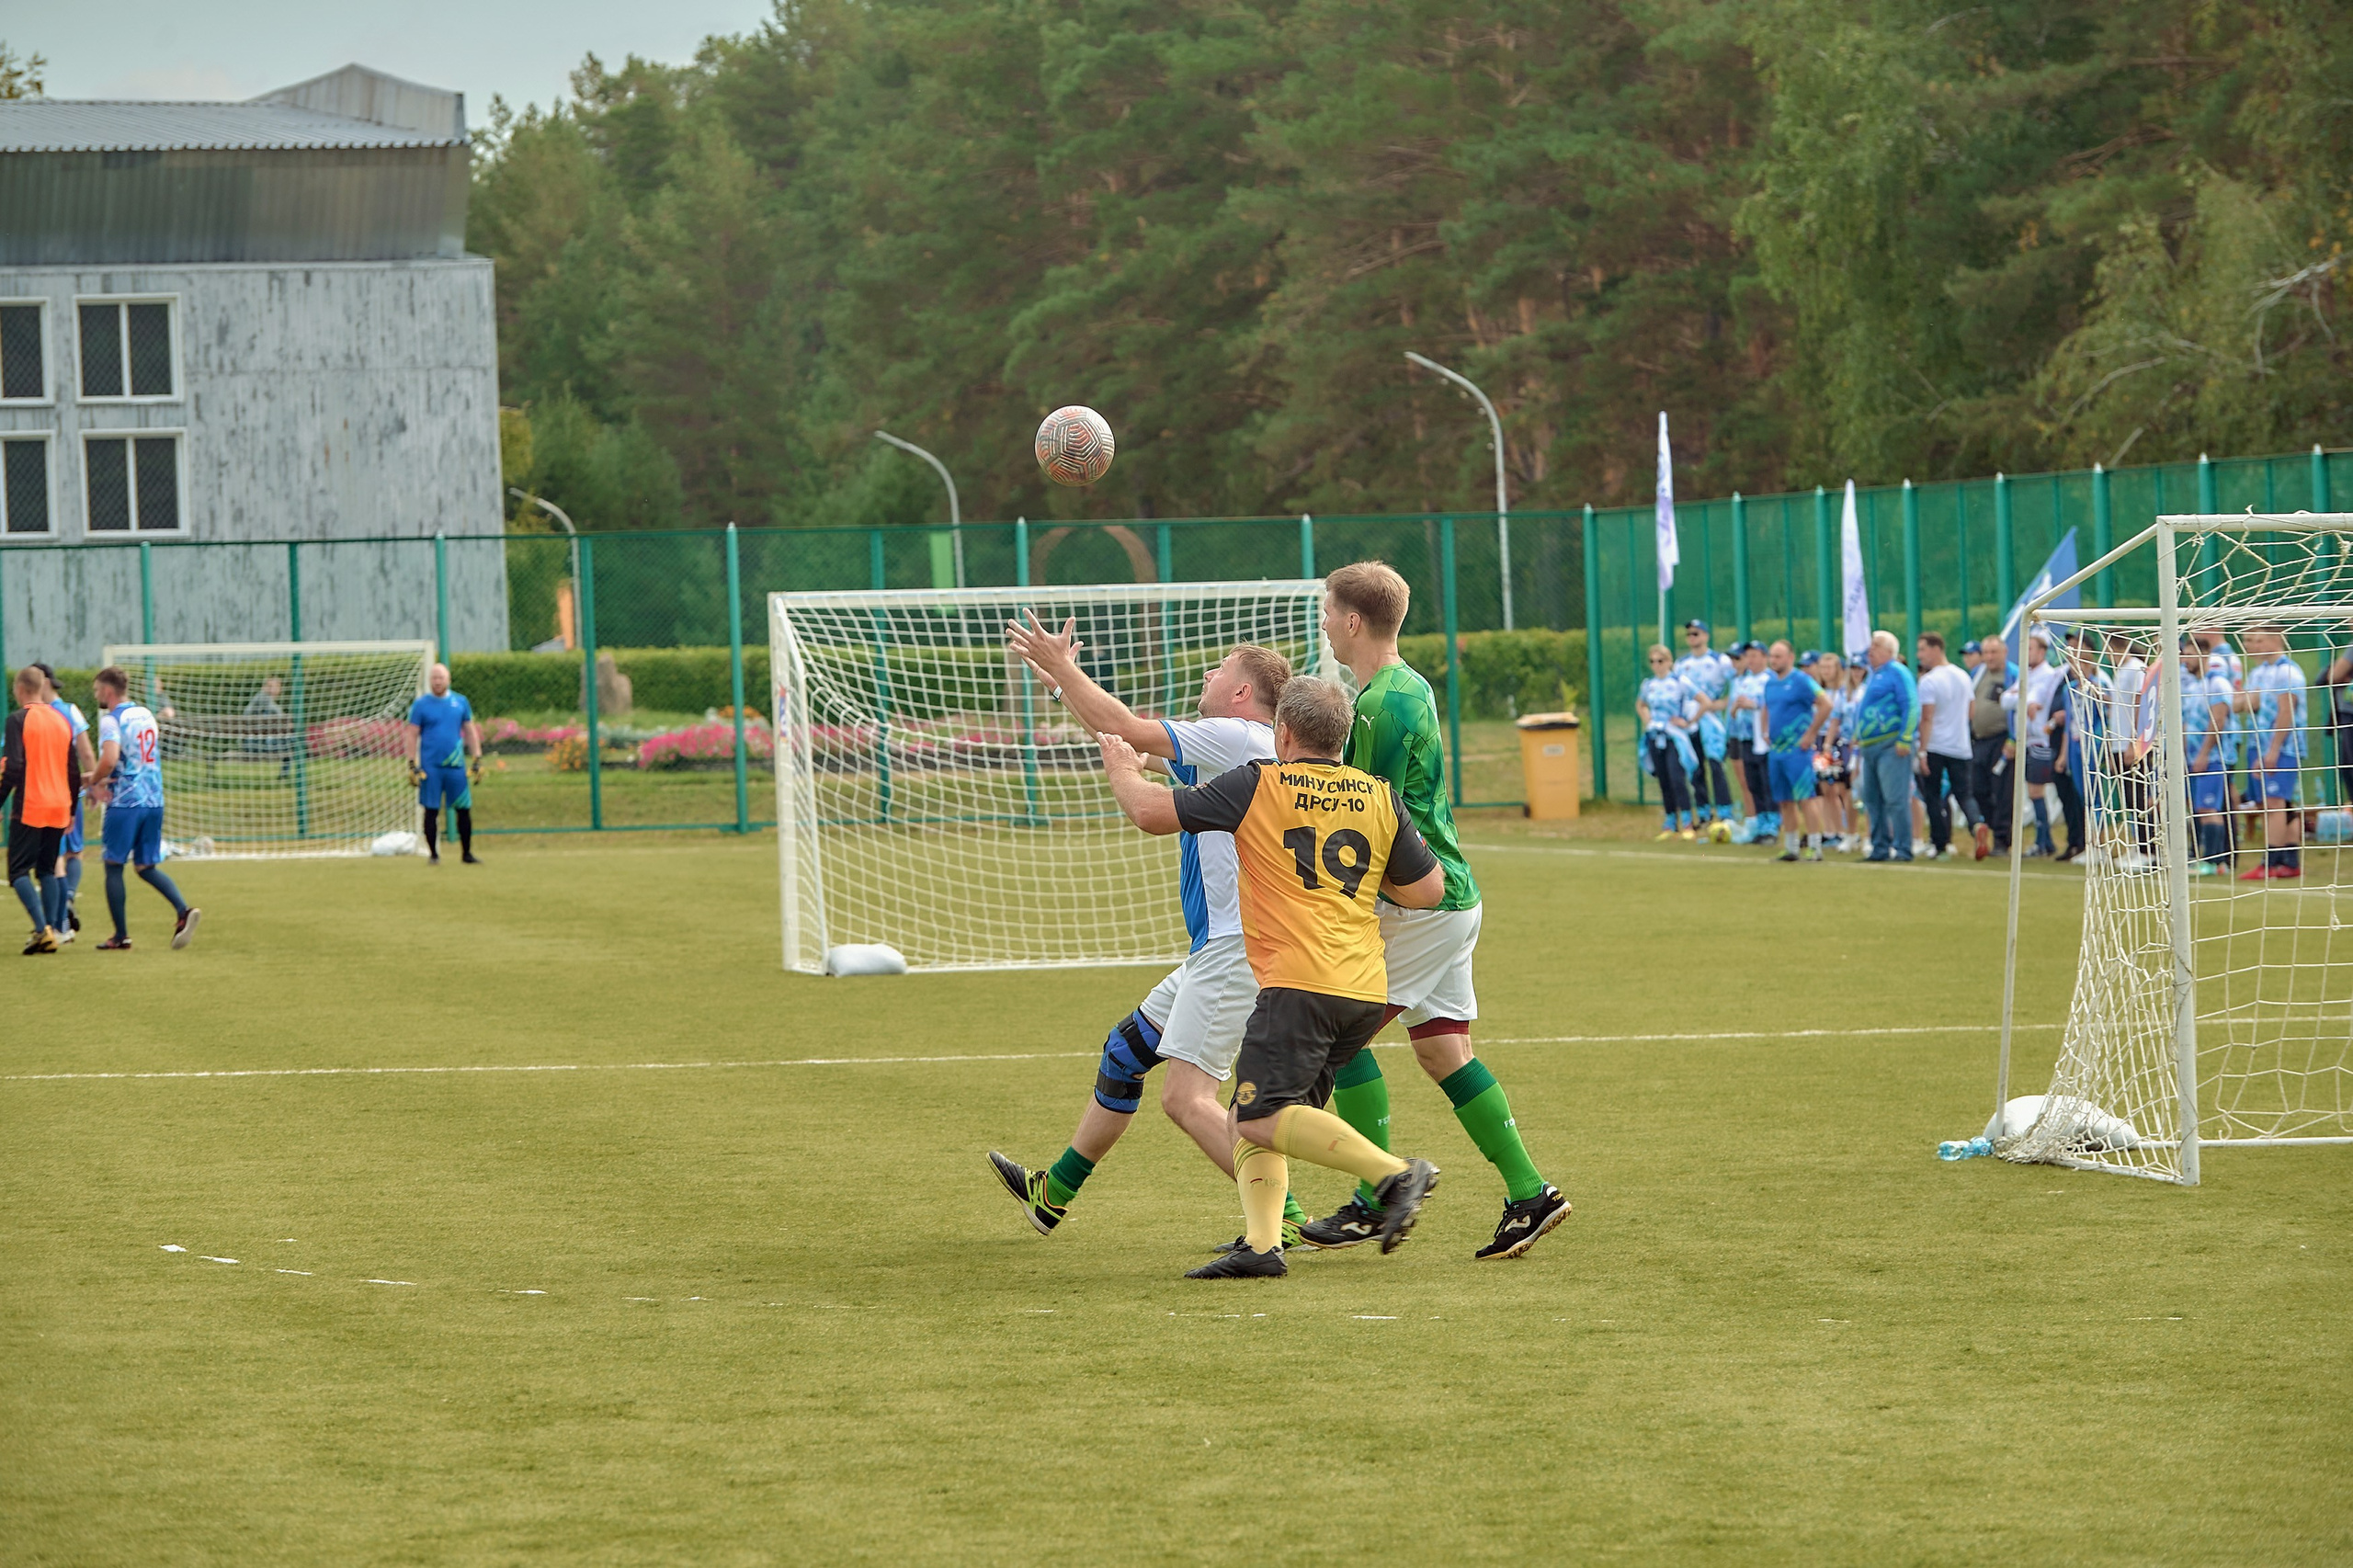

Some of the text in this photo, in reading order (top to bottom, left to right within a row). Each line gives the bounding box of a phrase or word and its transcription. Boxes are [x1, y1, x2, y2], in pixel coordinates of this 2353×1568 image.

[2143, 685, 2157, 743] 3
[136, 728, 155, 764] 12
[1294, 792, 1365, 812] ДРСУ-10
[1283, 825, 1371, 900] 19
